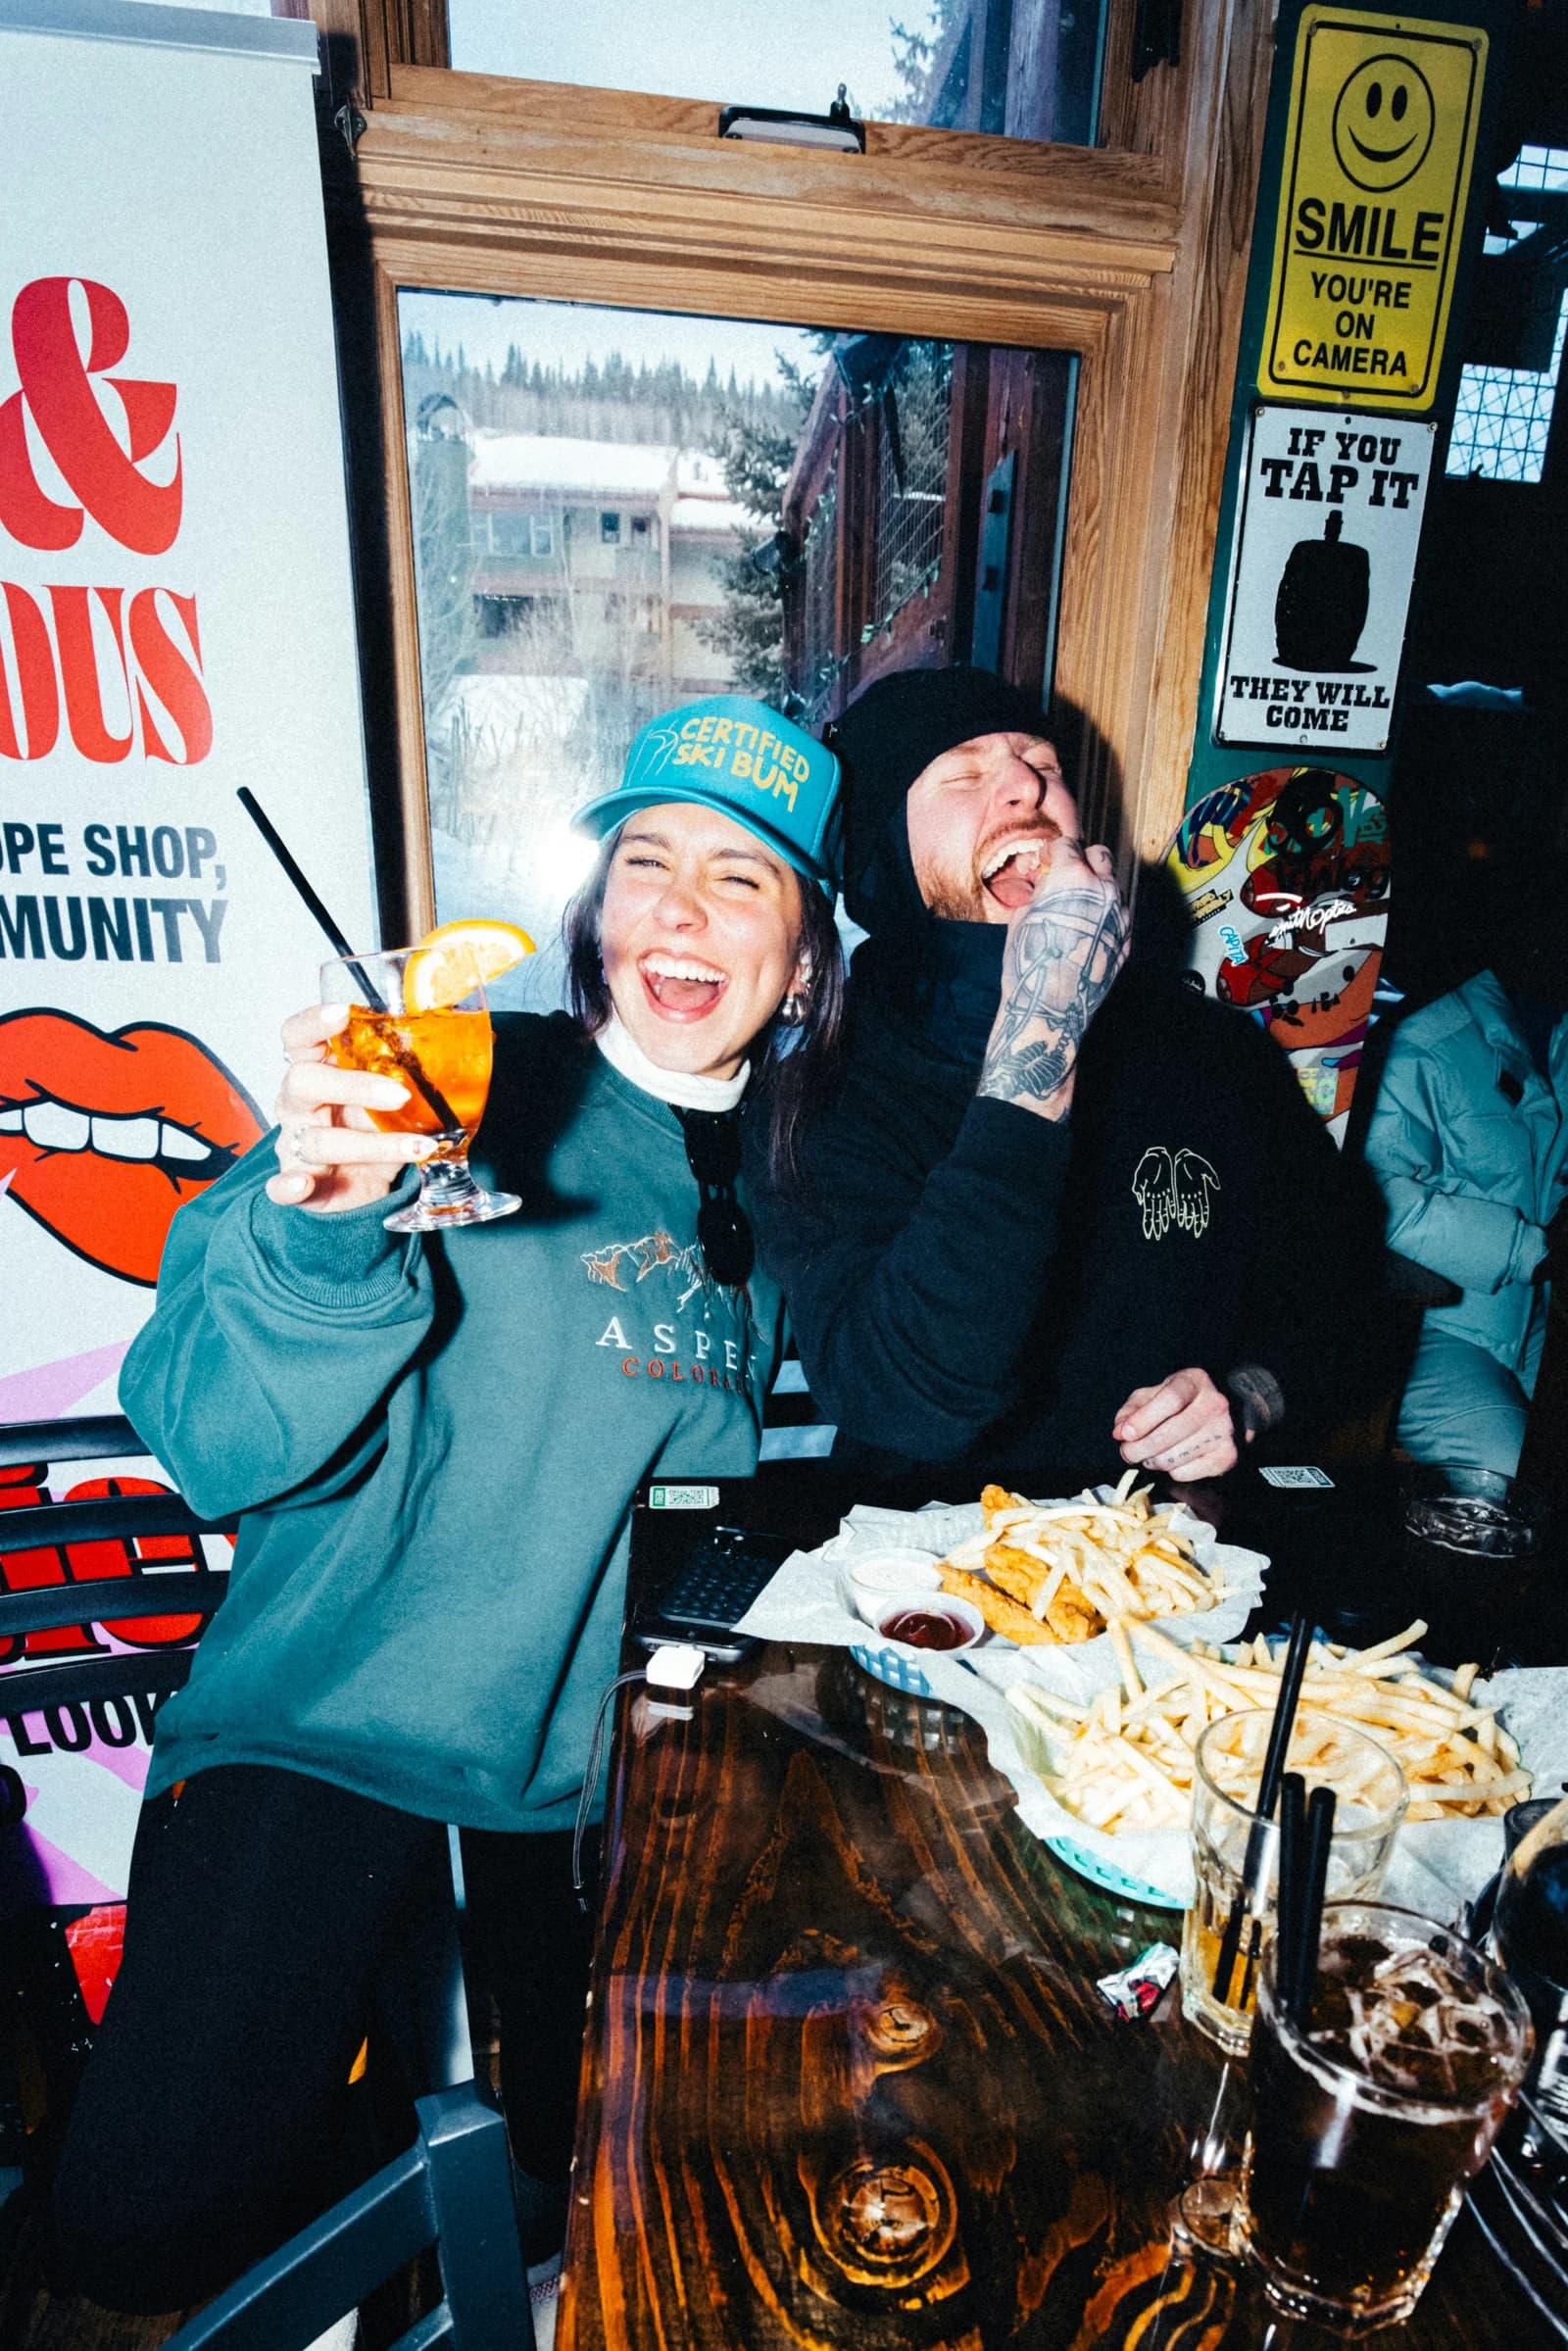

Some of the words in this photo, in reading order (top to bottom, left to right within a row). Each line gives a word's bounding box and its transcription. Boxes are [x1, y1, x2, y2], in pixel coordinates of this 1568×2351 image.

[1296, 198, 1445, 262] SMILE
[1311, 272, 1411, 309] YOU'RE
[1335, 311, 1375, 340] ON
[1293, 340, 1407, 377] CAMERA
[0, 276, 182, 556] &
[1288, 427, 1325, 458] IF
[1336, 432, 1401, 465] YOU
[1260, 458, 1358, 504] TAP
[1368, 470, 1419, 510] IT
[1230, 675, 1315, 702] THEY
[1315, 682, 1391, 709] WILL
[1266, 707, 1348, 732] COME
[680, 716, 810, 782] CERTIFIED
[672, 743, 725, 768] SKI
[731, 752, 799, 812] BUM
[0, 822, 70, 875] PE
[83, 823, 227, 890] SHOP,
